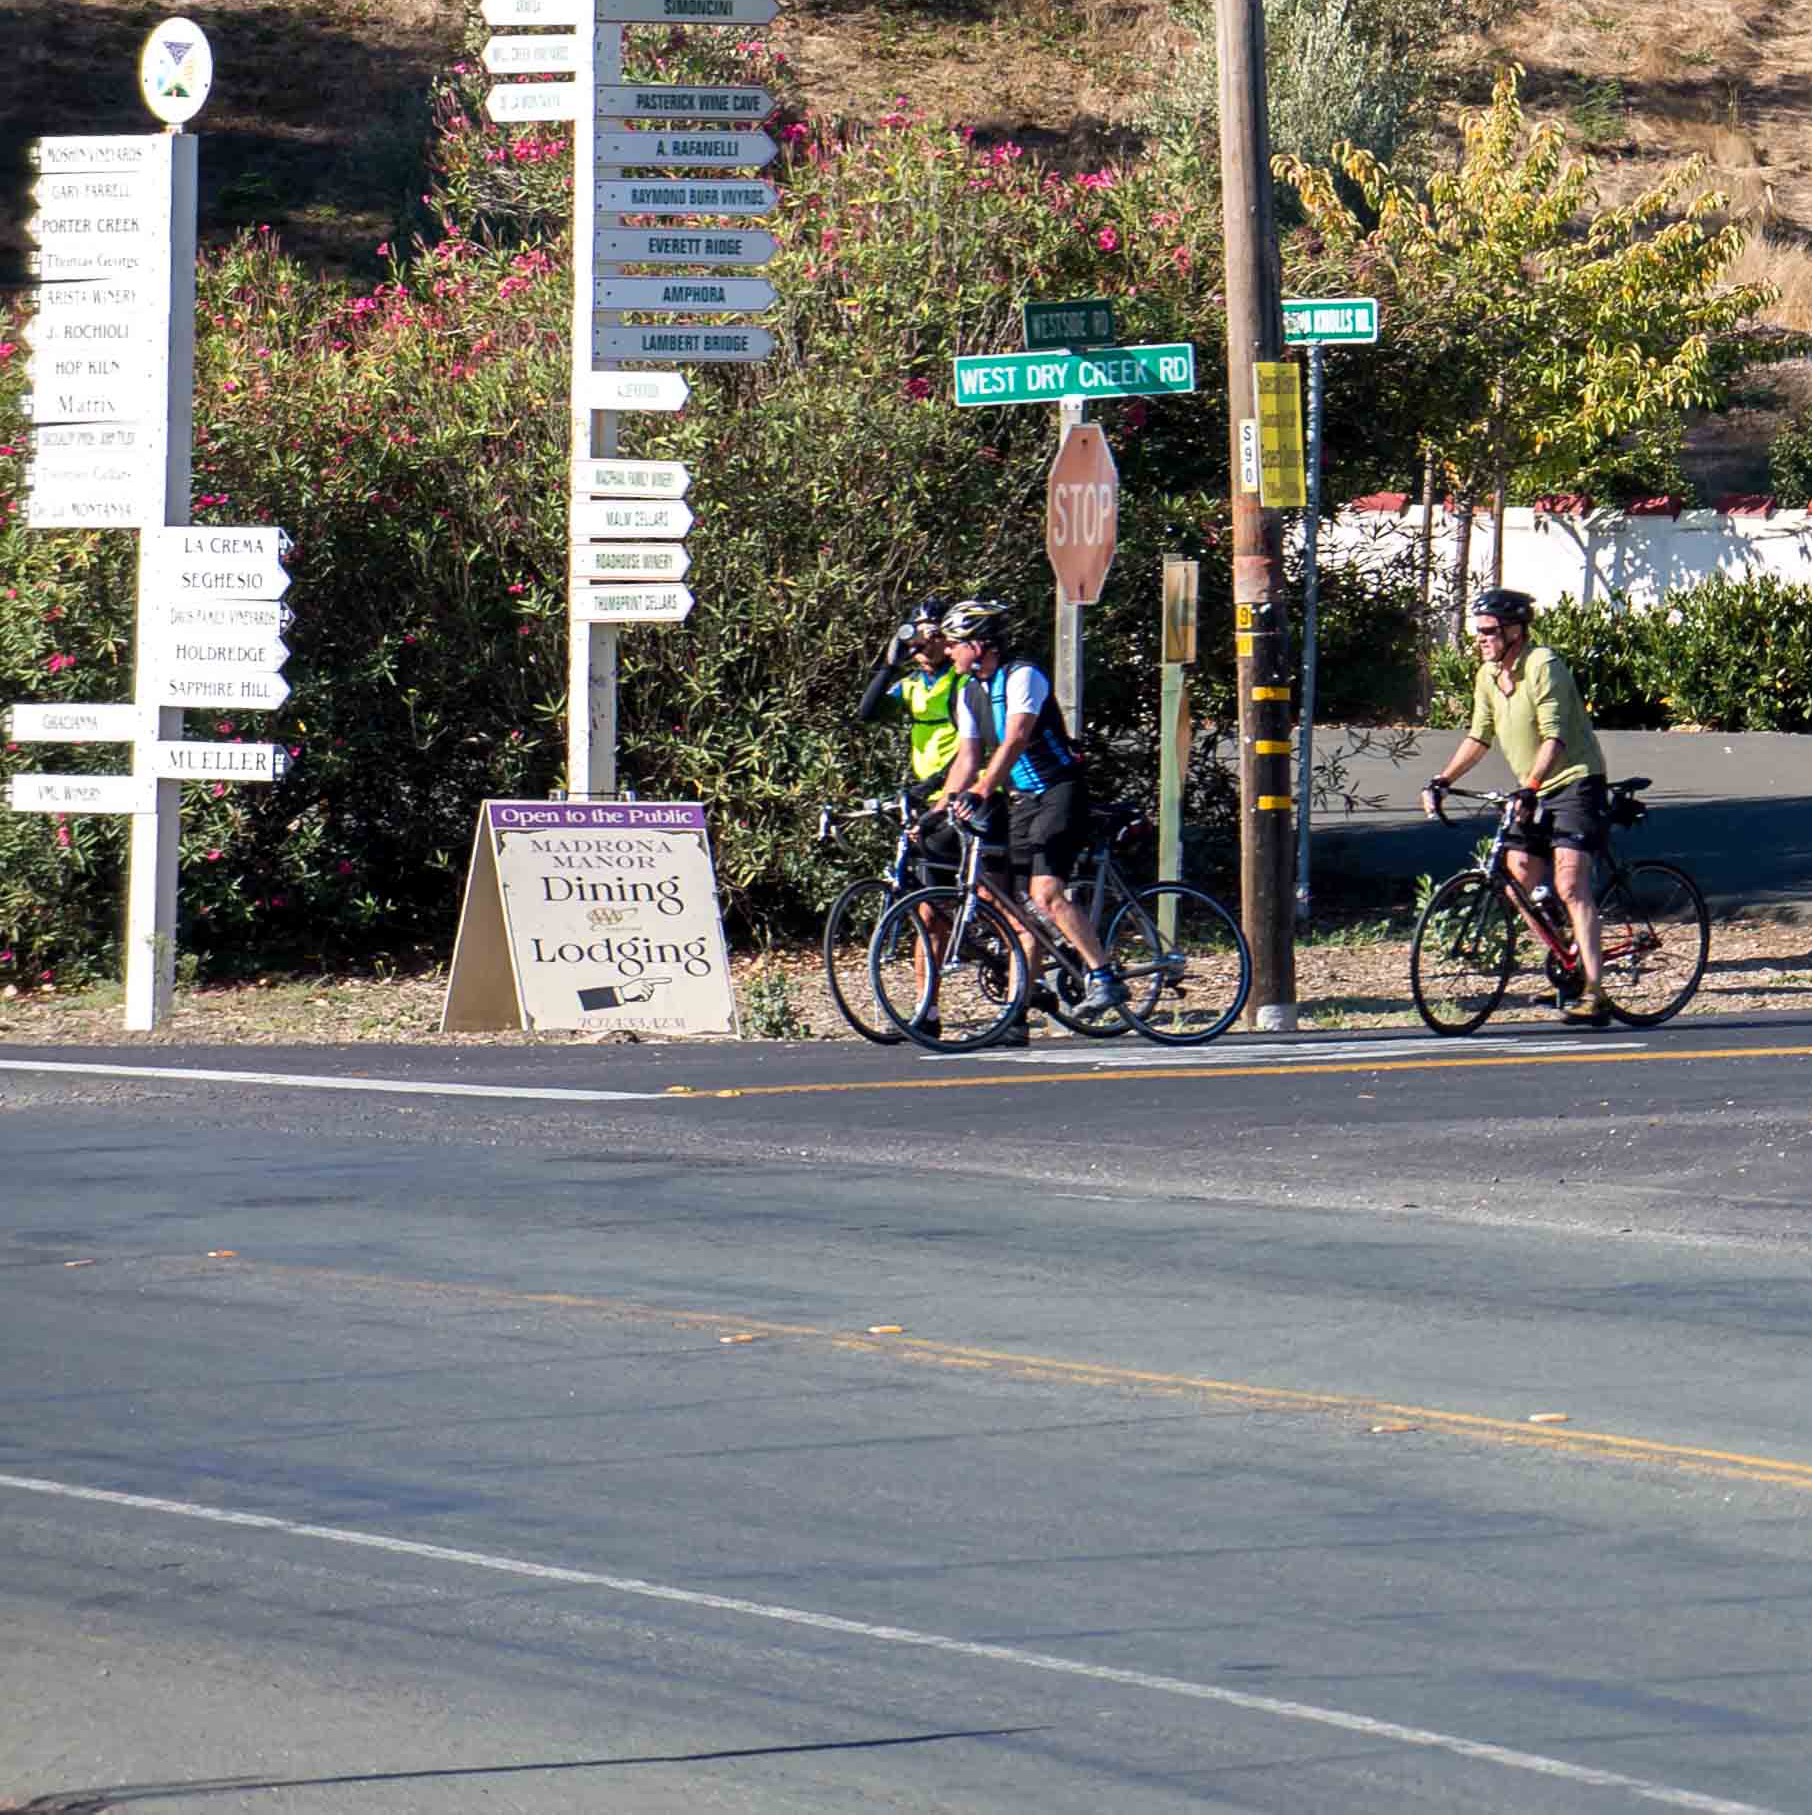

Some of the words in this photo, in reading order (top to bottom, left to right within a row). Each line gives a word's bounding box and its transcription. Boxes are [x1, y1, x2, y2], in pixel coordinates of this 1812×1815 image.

[636, 93, 696, 111] PASTERICK
[698, 94, 730, 111] WINE
[733, 94, 760, 112] CAVE
[656, 140, 669, 157] A.
[672, 140, 739, 157] RAFANELLI
[689, 188, 719, 205] BURR
[42, 218, 92, 234] PORTER
[97, 218, 141, 233] CREEK
[648, 238, 702, 254] EVERETT
[705, 238, 742, 255] RIDGE
[662, 285, 726, 303] AMPHORA
[64, 323, 129, 339] ROCHIOLI
[641, 334, 701, 351] LAMBERT
[703, 335, 749, 352] BRIDGE
[56, 362, 83, 376] HOP
[88, 362, 121, 376] KILN
[960, 366, 1018, 395] WEST
[1026, 361, 1069, 392] DRY
[1078, 358, 1149, 388] CREEK
[1159, 355, 1188, 384] RD
[58, 394, 117, 414] Matrix
[1055, 482, 1113, 546] STOP
[185, 538, 204, 554] LA
[210, 537, 264, 554] CREMA
[182, 572, 263, 589] SEGHESIO
[176, 644, 266, 662] HOLDREDGE
[169, 680, 235, 697] SAPPHIRE
[241, 681, 271, 698] HILL
[170, 750, 267, 771] MUELLER
[501, 808, 560, 826] Open
[566, 809, 585, 824] to
[592, 808, 624, 823] the
[629, 809, 694, 824] Public
[530, 839, 673, 854] MADRONA
[552, 855, 657, 869] MANOR
[541, 875, 685, 916] Dining
[531, 937, 711, 977] Lodging
